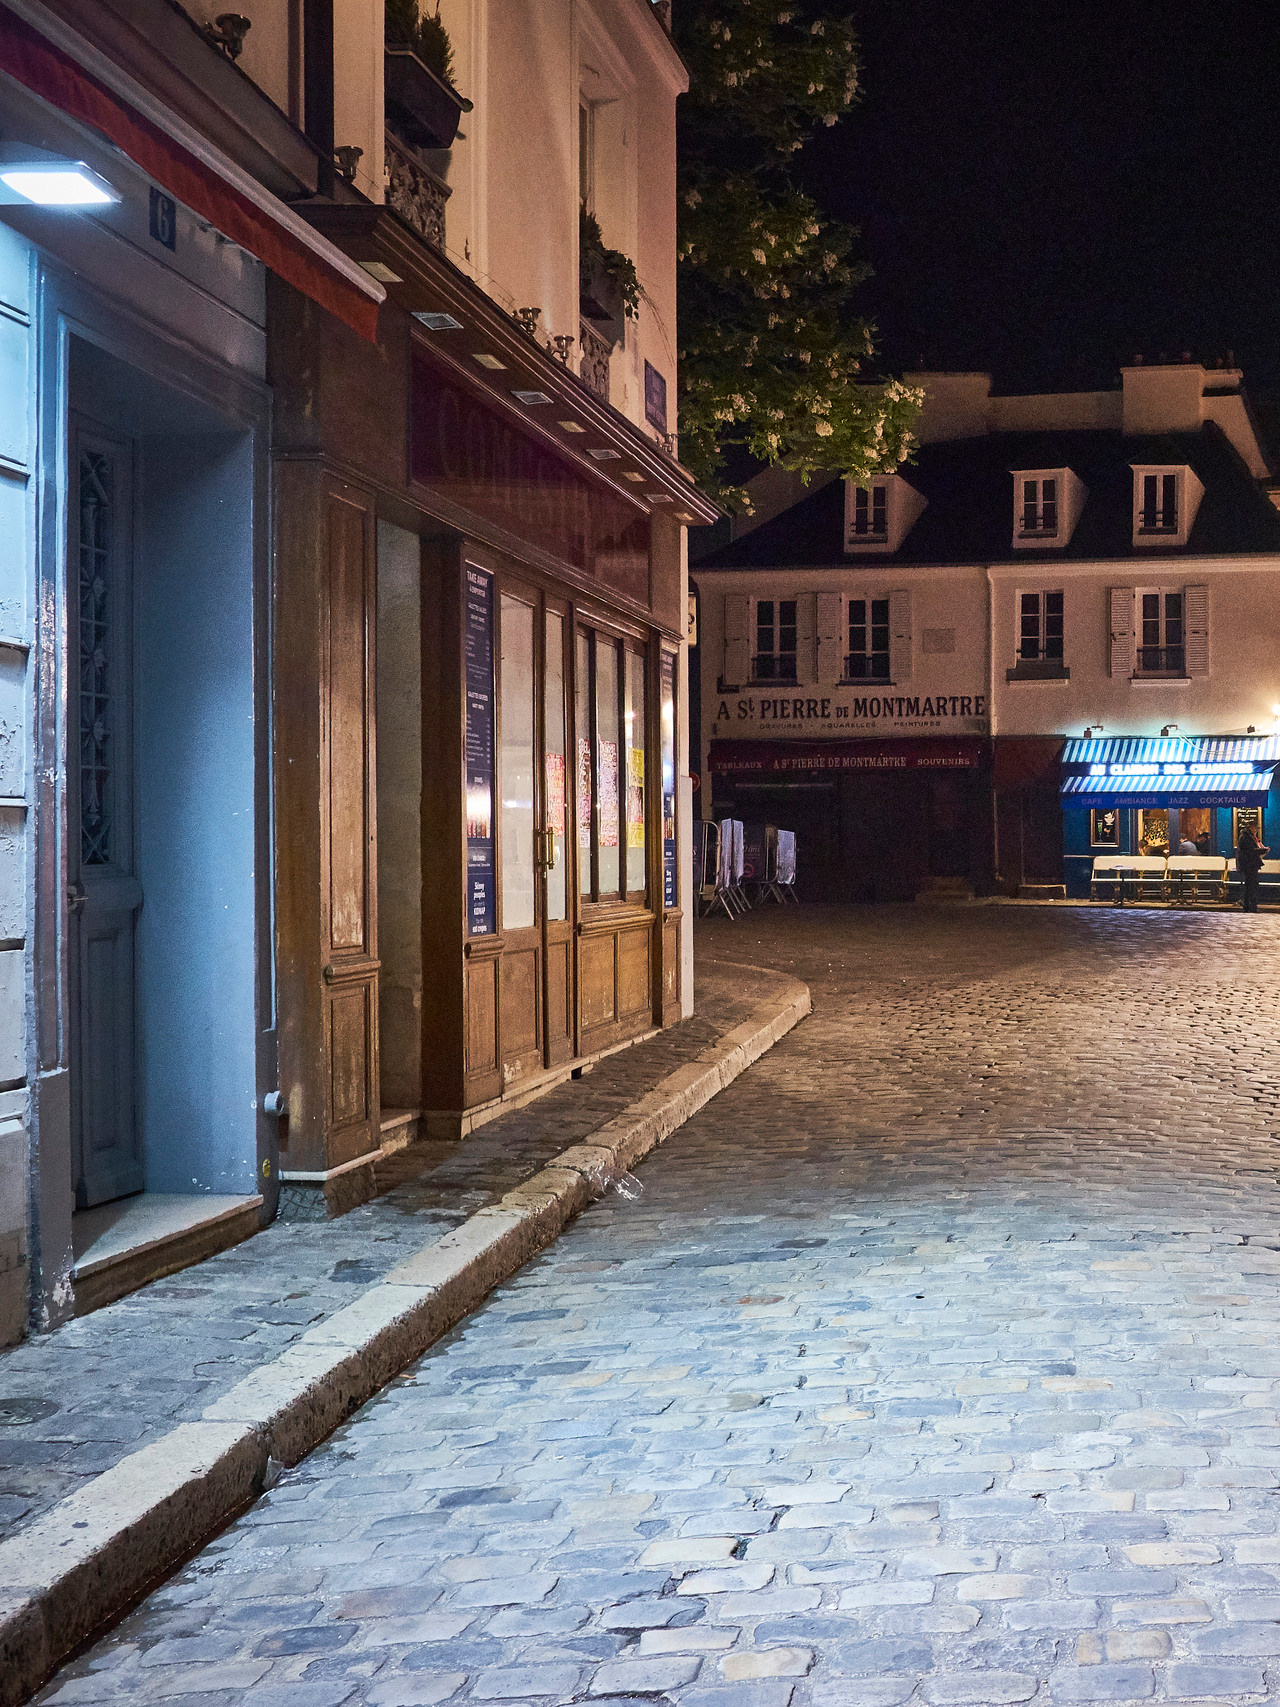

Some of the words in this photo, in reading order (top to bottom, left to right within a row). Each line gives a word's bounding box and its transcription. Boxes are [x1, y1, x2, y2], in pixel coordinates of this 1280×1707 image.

[157, 196, 170, 242] 6
[716, 700, 731, 720] A
[760, 698, 831, 719] PIERRE
[836, 706, 849, 718] DE
[853, 695, 985, 718] MONTMARTRE
[717, 761, 762, 769] TABLEAUX
[791, 758, 826, 769] PIERRE
[828, 758, 840, 768] DE
[842, 756, 907, 768] MONTMARTRE
[917, 758, 970, 766] SOUVENIRS
[1114, 797, 1159, 805] AMBIANCE
[1168, 796, 1189, 804] JAZZ
[1200, 796, 1247, 804] COCKTAILS
